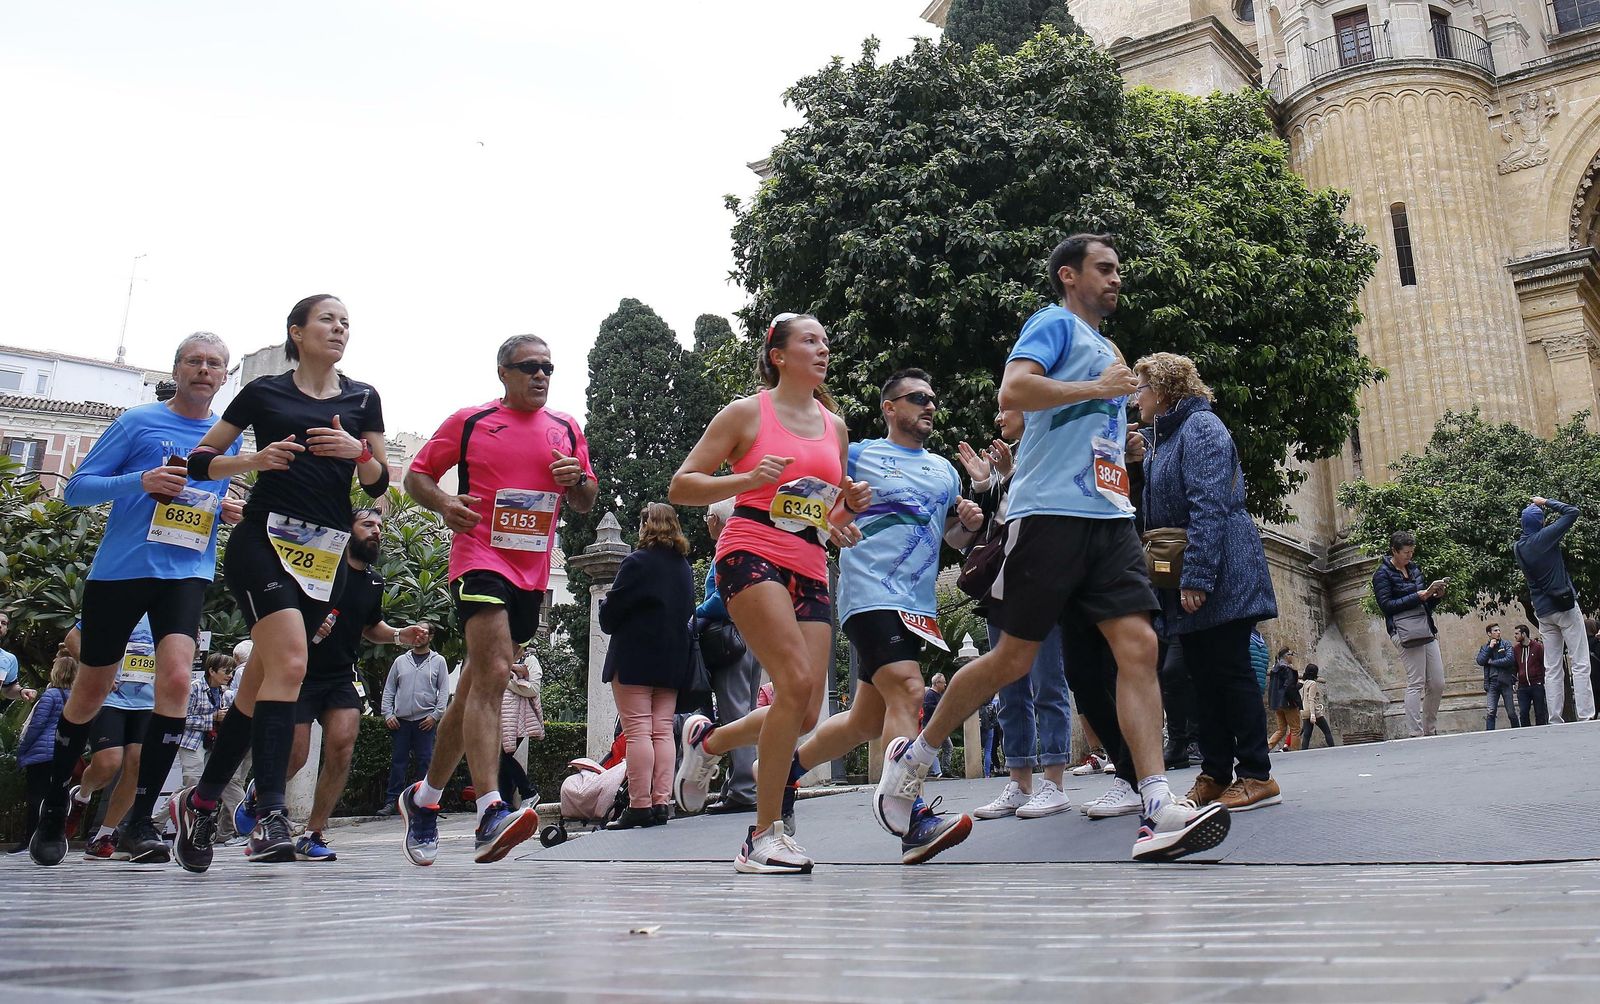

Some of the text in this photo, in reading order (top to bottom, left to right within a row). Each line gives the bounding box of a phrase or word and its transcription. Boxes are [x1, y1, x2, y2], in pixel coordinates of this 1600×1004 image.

[1099, 464, 1122, 486] 3847
[165, 507, 202, 526] 6833
[783, 500, 822, 519] 6343
[500, 512, 537, 528] 5153
[130, 657, 155, 669] 6189
